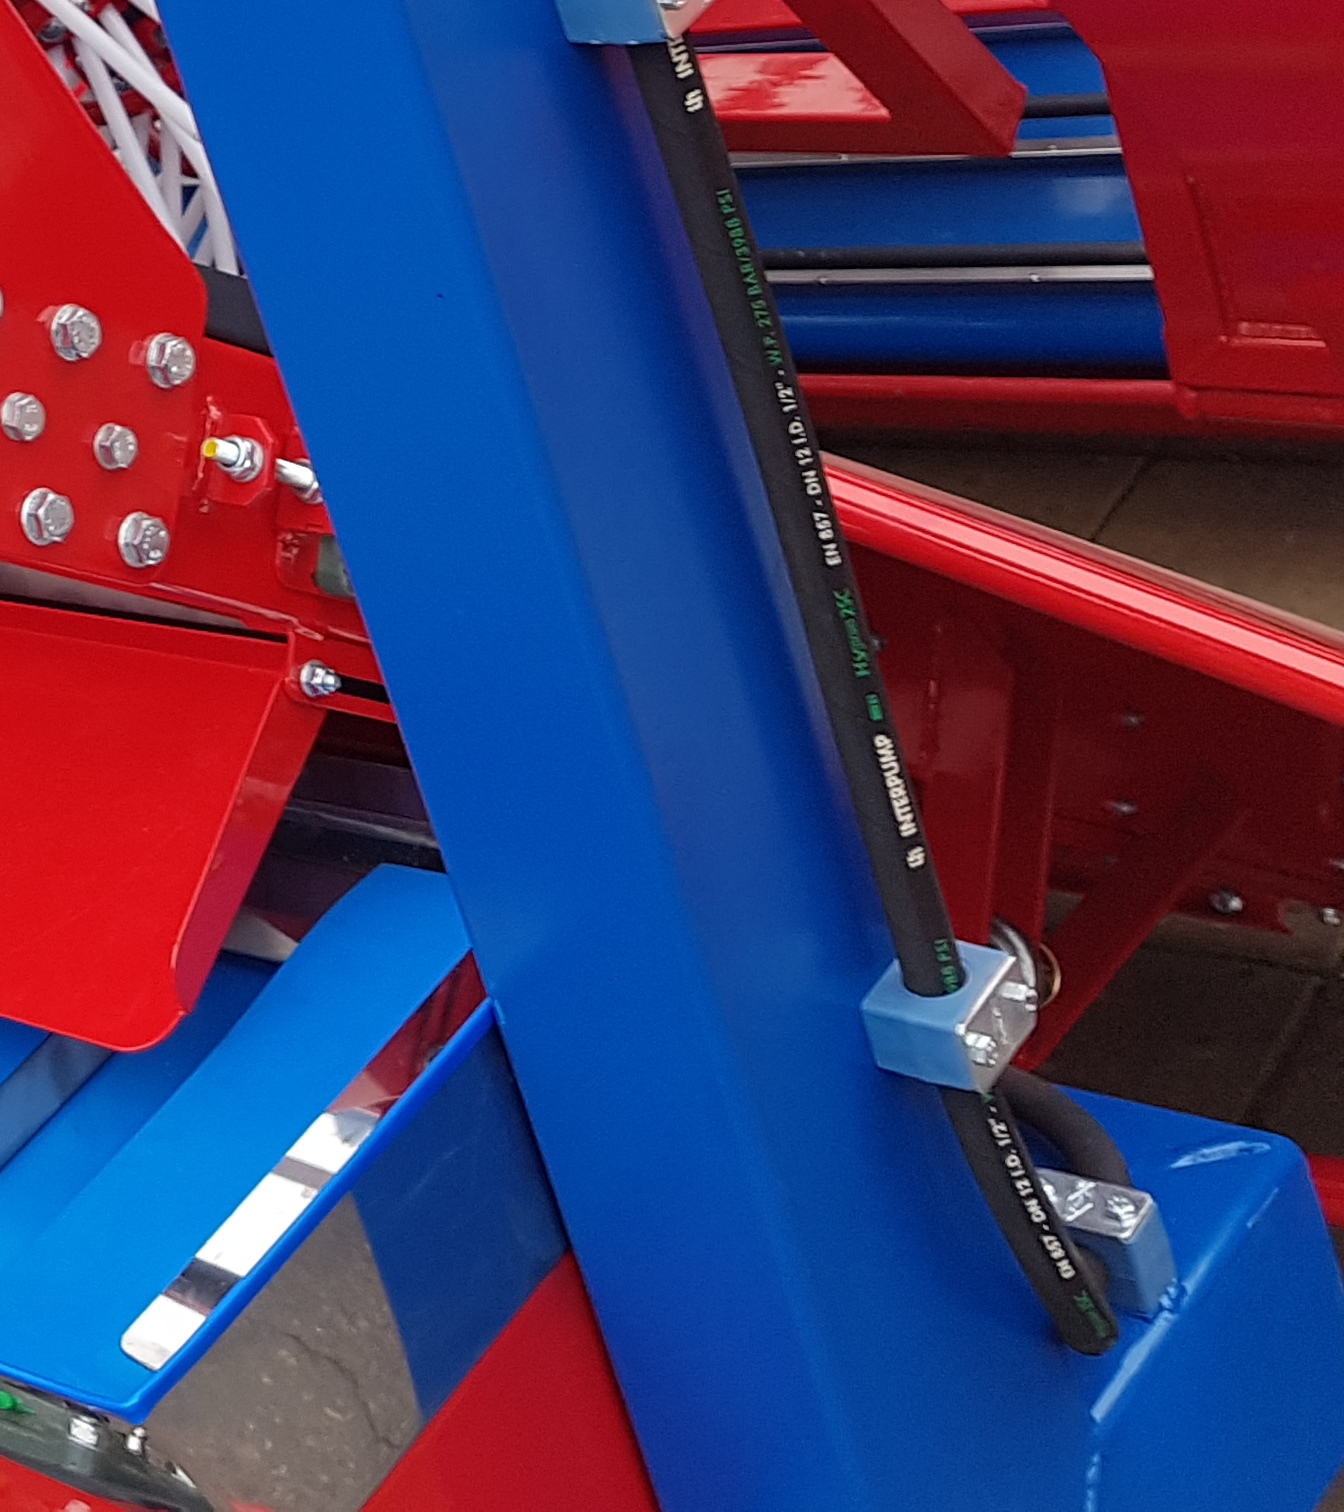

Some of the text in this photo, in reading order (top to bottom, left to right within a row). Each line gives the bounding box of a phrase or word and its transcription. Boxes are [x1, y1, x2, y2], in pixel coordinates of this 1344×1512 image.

[716, 188, 735, 214] PSI
[795, 447, 813, 466] 12
[802, 469, 823, 496] DN
[822, 542, 843, 567] EN
[873, 734, 917, 838] INTERPUMP
